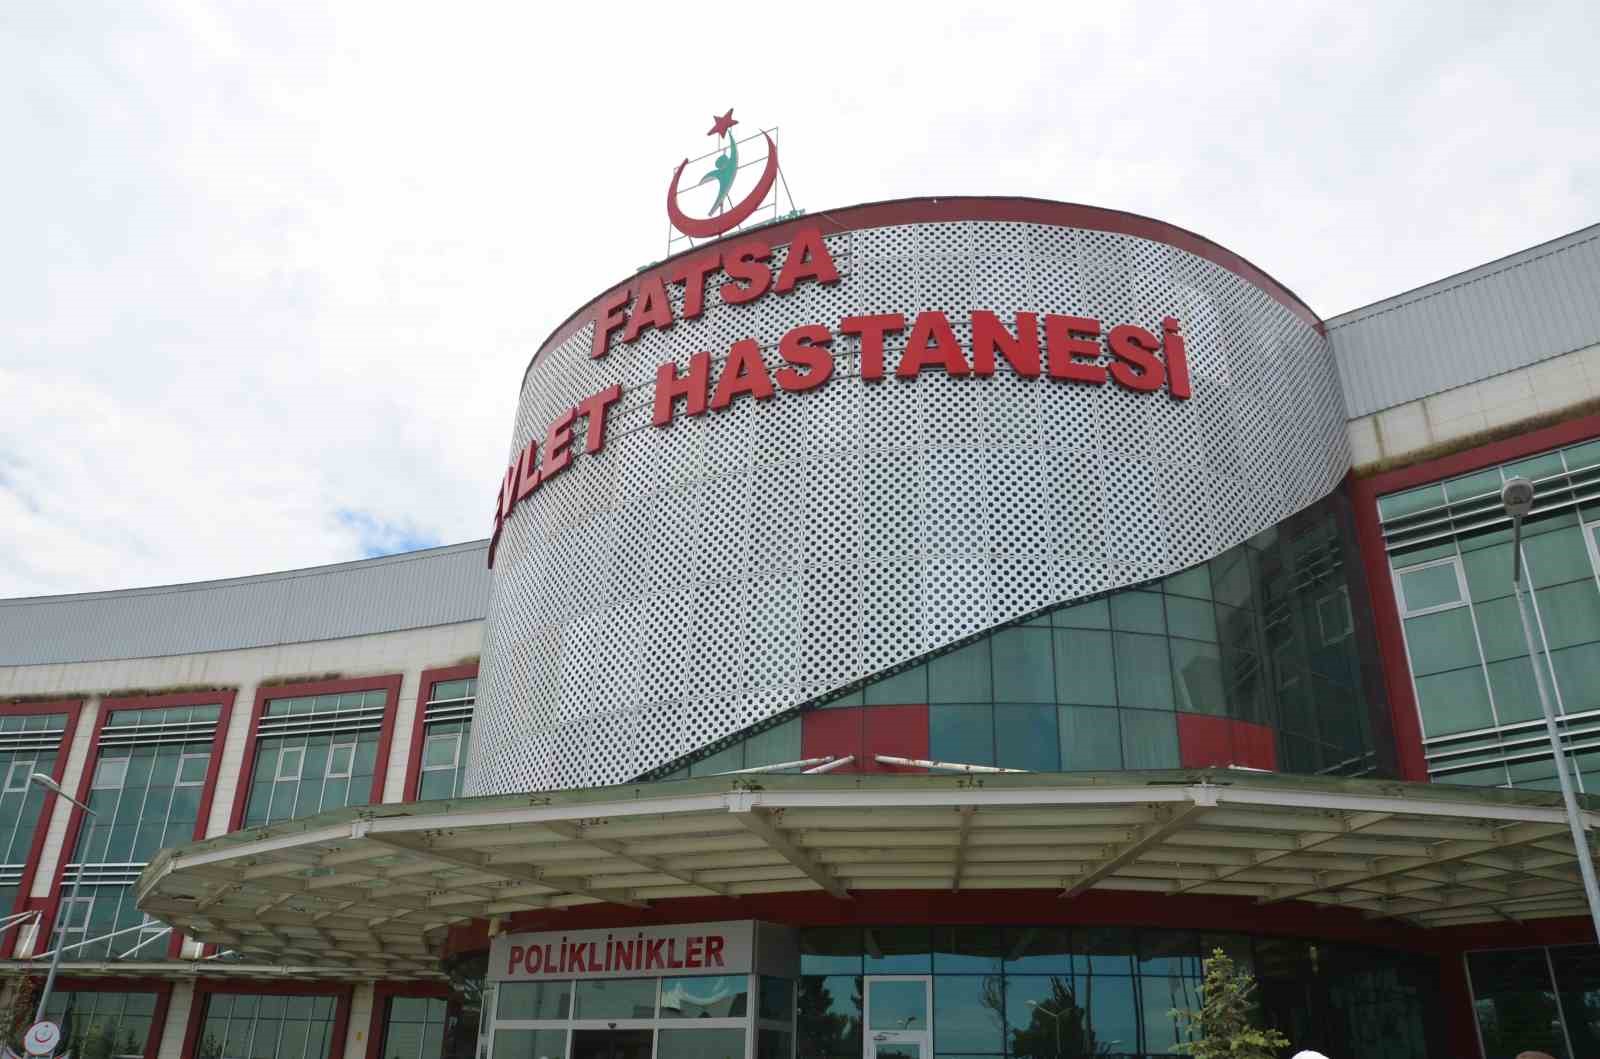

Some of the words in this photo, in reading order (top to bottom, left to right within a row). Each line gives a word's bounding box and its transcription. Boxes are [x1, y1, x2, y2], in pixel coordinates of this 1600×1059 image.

[591, 227, 841, 360] FATSA
[652, 309, 1192, 428] HASTANESİ
[507, 932, 726, 975] POLİKLİNİKLER
